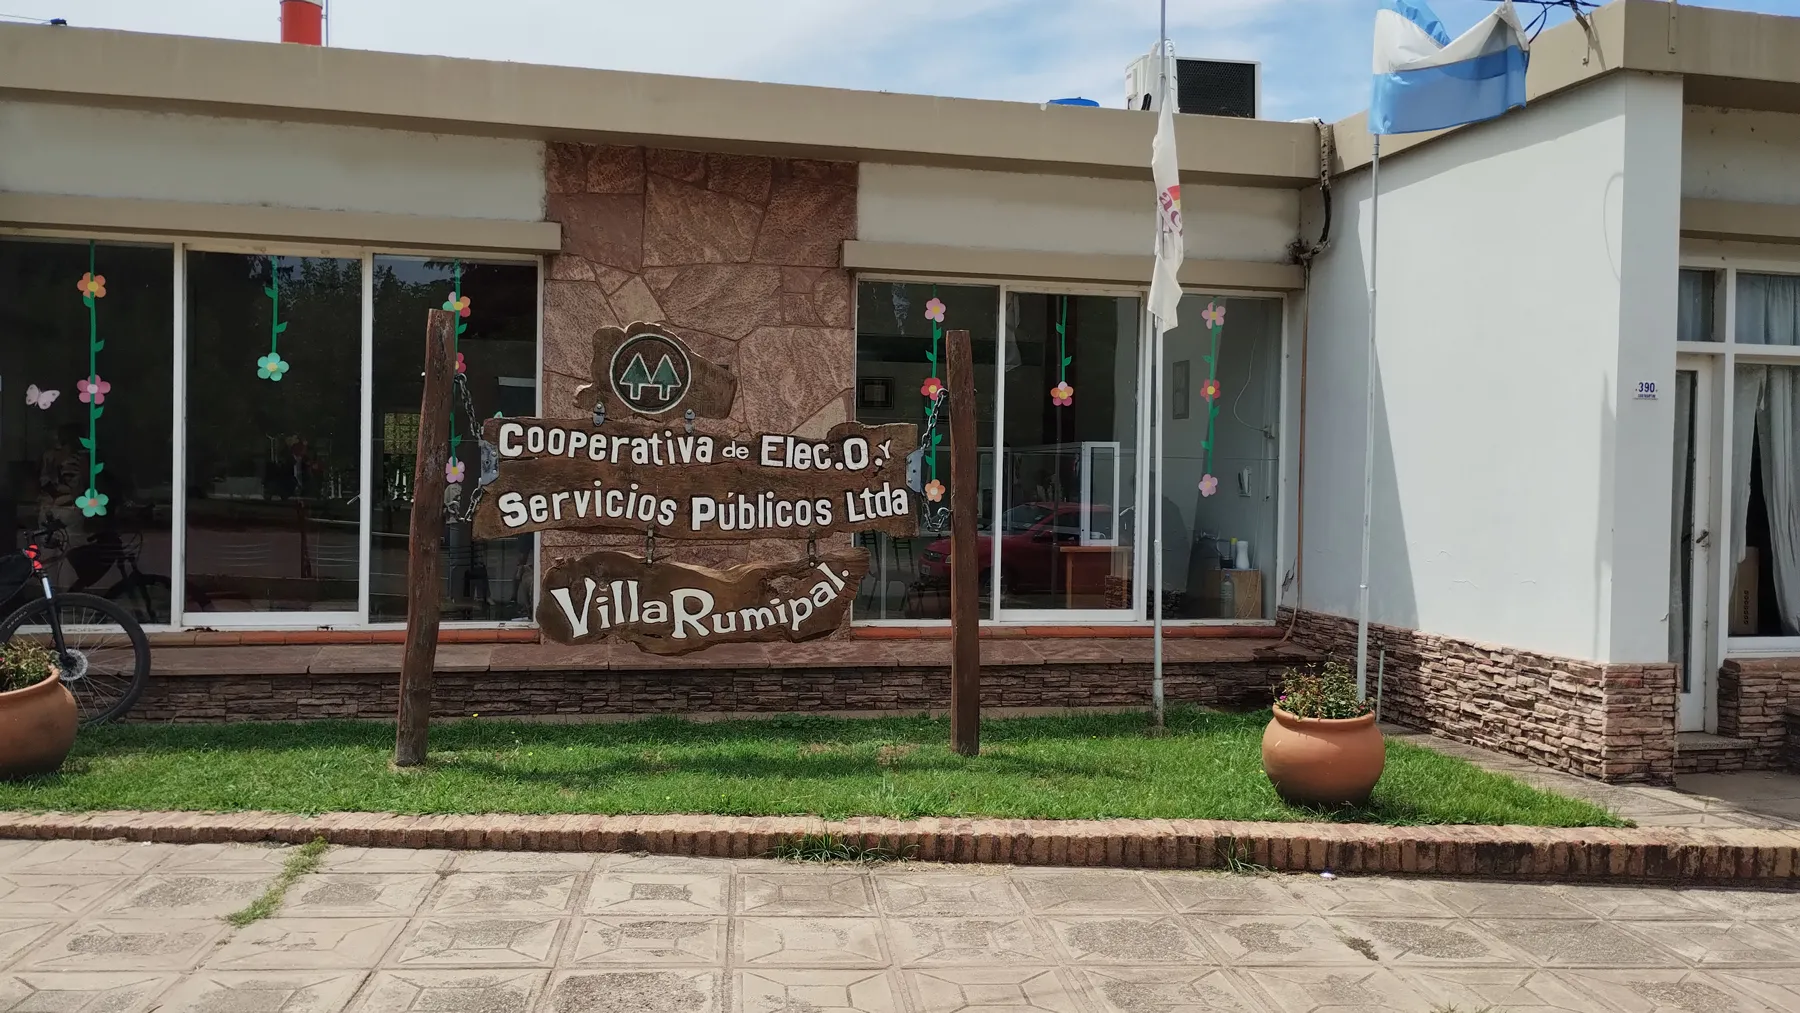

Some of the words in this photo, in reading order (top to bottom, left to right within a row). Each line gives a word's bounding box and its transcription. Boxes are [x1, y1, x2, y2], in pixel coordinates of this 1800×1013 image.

[1638, 382, 1655, 393] 390
[500, 423, 714, 466] Cooperativa
[722, 440, 749, 460] de
[499, 480, 677, 527] Servicios
[691, 490, 832, 531] Públicos
[846, 482, 909, 522] Ltda
[550, 577, 669, 639] Villa
[669, 561, 851, 640] Rumipal.
